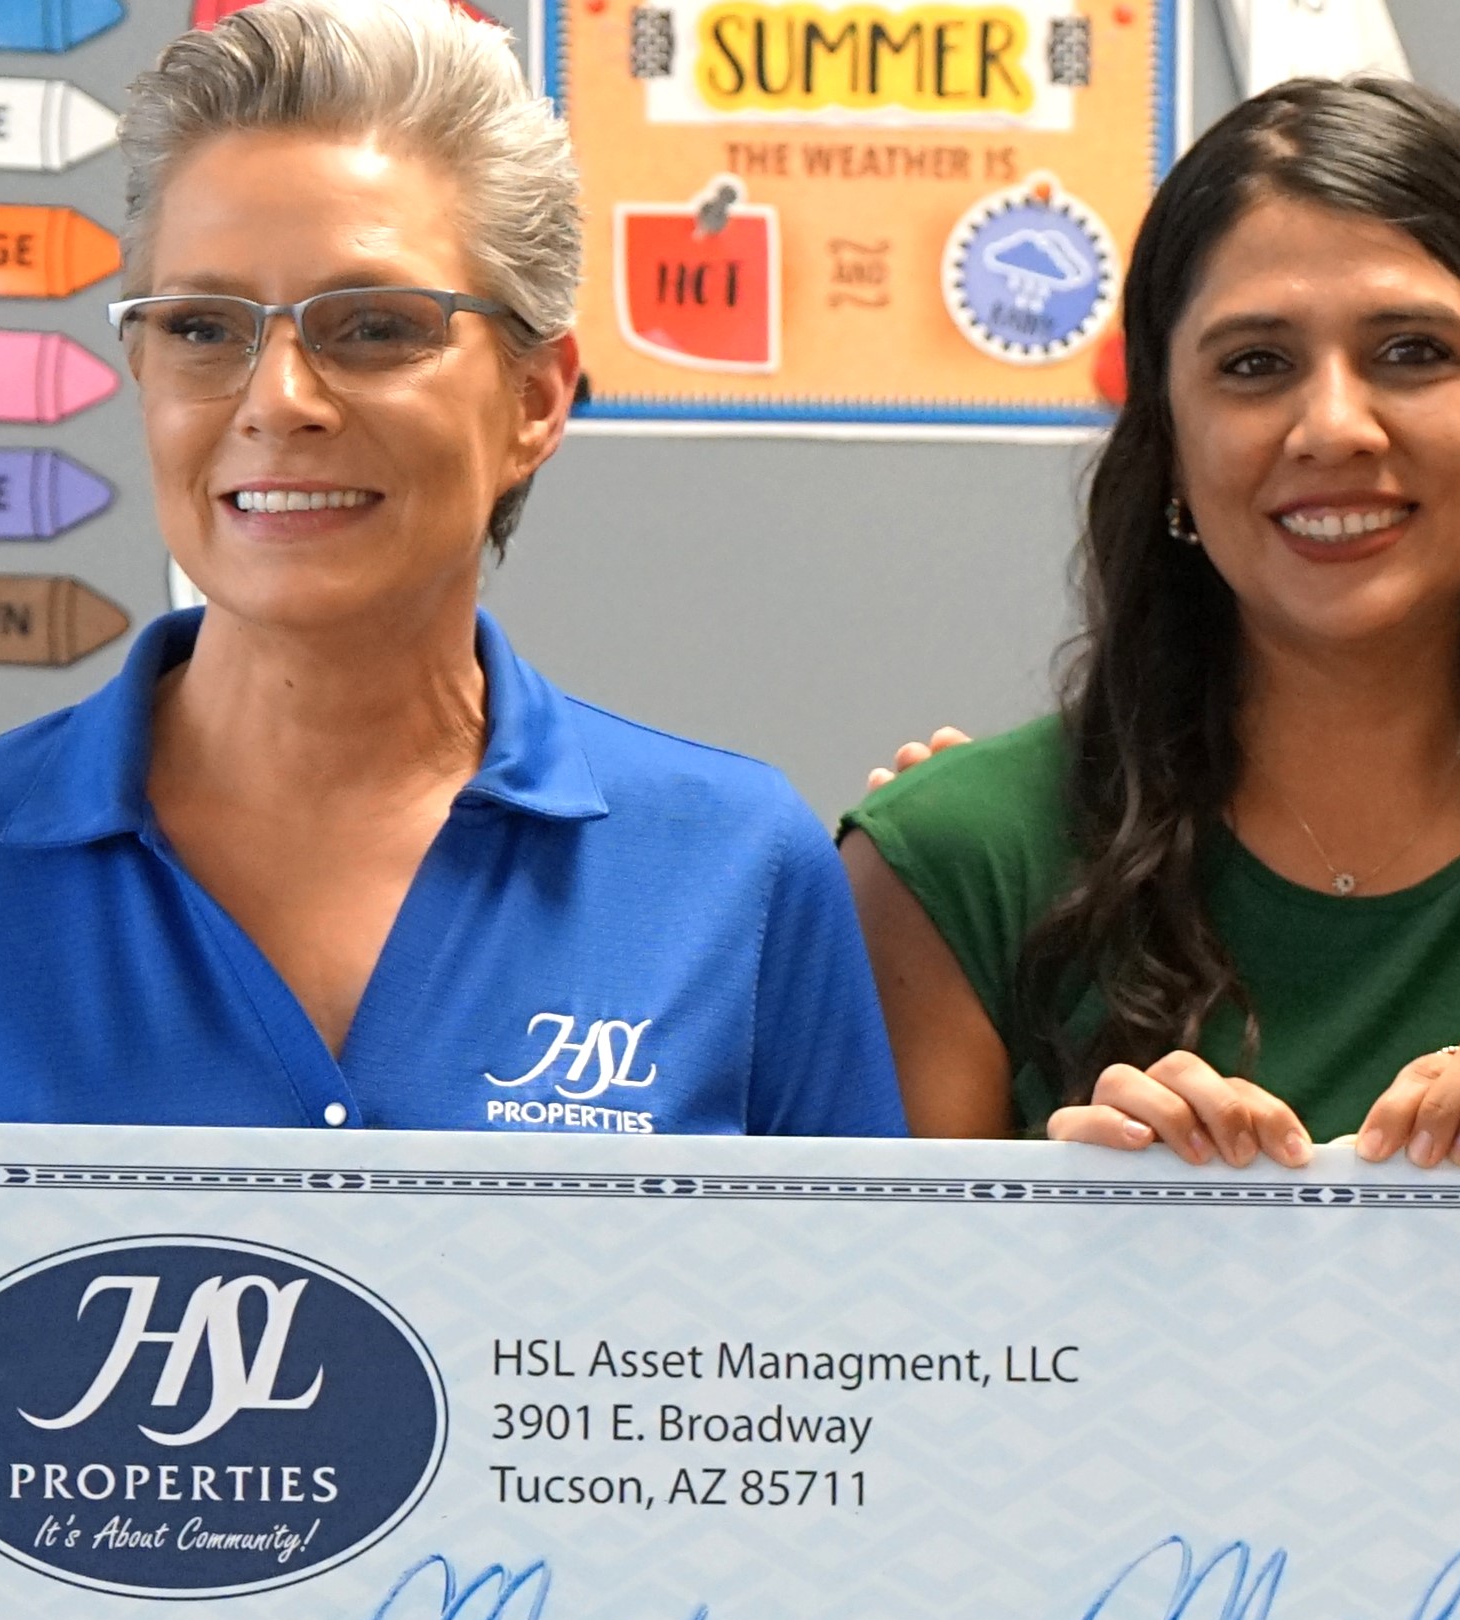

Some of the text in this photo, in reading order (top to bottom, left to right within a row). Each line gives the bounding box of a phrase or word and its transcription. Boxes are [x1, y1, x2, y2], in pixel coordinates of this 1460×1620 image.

[708, 13, 1034, 101] SUMMER
[724, 142, 1019, 180] THE WEATHER IS
[655, 260, 742, 308] HOT
[483, 1012, 657, 1100] HSL
[486, 1100, 654, 1135] PROPERTIES
[15, 1273, 325, 1448] HSL
[492, 1338, 1081, 1392] HSL Asset Managment, LLC
[491, 1403, 874, 1455] 3901 E. Broadway
[8, 1462, 339, 1504] PROPERTIES
[489, 1465, 868, 1510] Tucson, AZ 85711
[33, 1513, 321, 1565] It's About Community!
